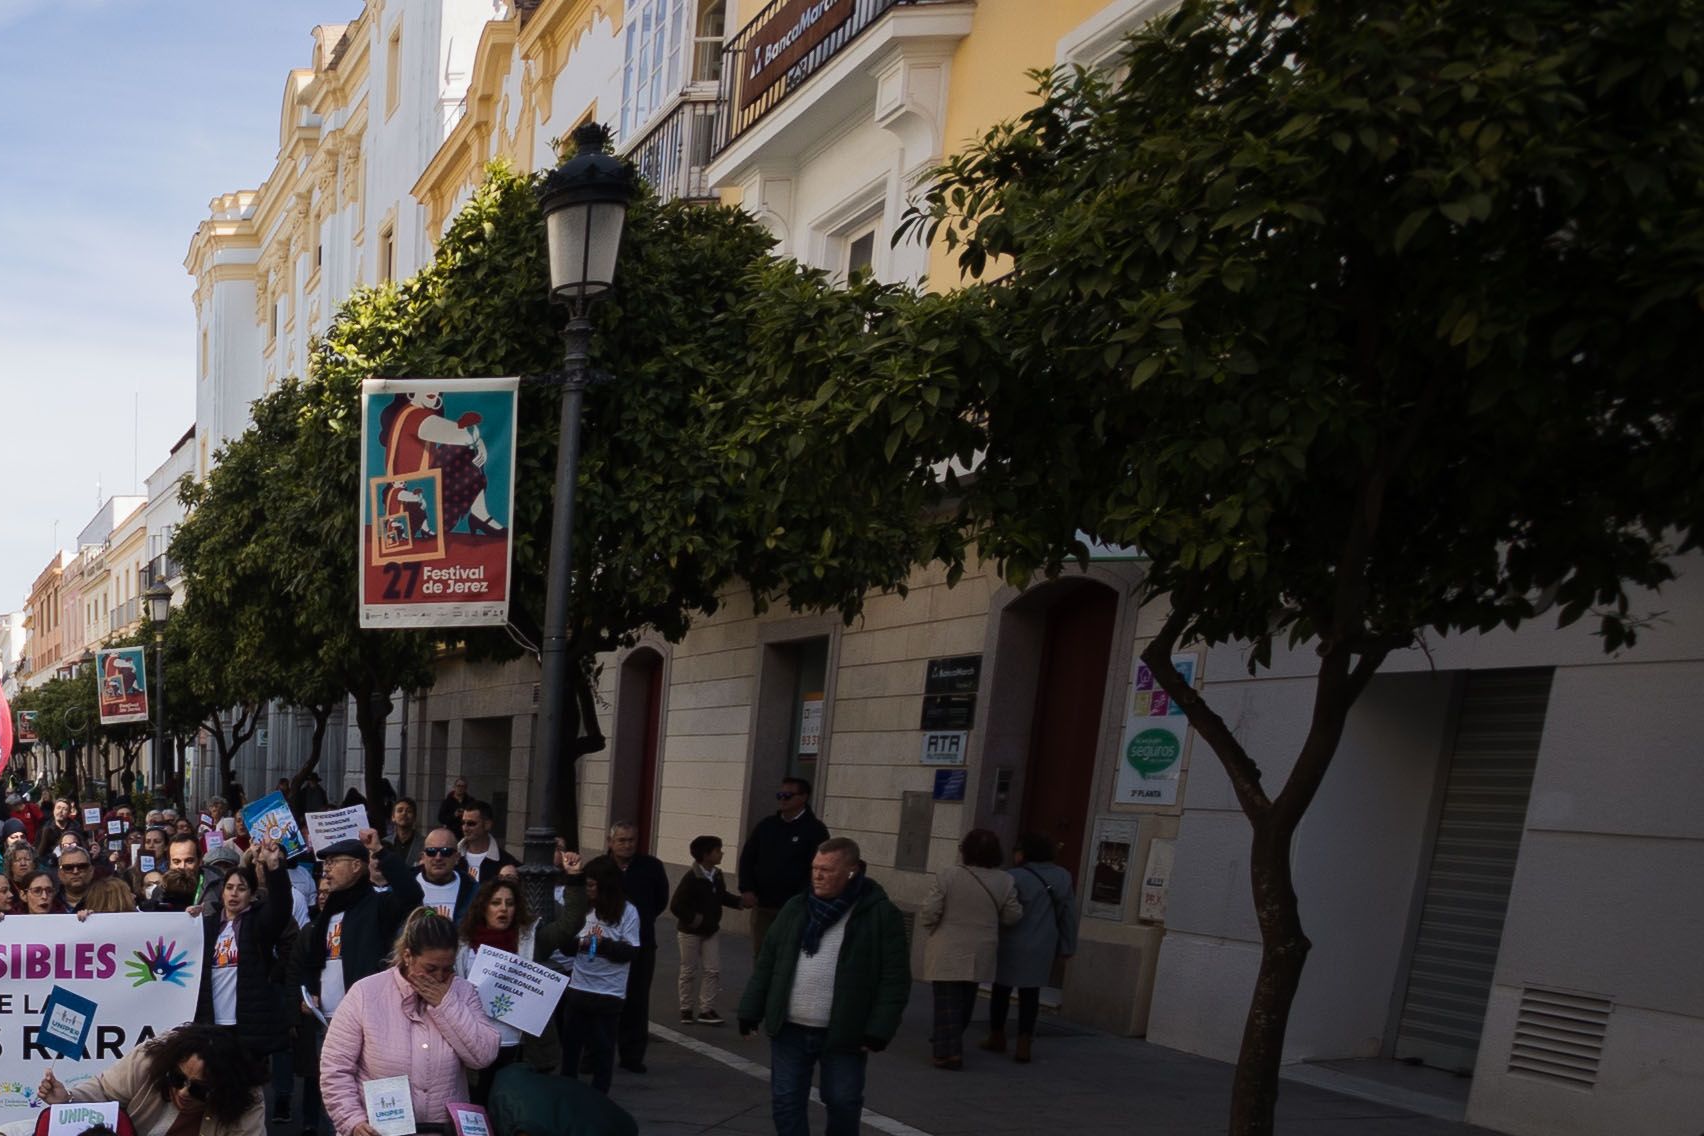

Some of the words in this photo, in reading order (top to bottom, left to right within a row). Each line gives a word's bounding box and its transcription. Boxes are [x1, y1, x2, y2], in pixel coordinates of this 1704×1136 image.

[764, 0, 838, 66] BancaMarc
[383, 561, 421, 600] 27
[423, 565, 484, 580] Festival
[423, 580, 442, 593] de
[446, 579, 488, 593] Jerez
[1130, 745, 1176, 760] seguros
[482, 949, 508, 961] SOMOS
[509, 957, 518, 965] LA
[518, 961, 562, 983] ASOCIACIÓN
[52, 1020, 79, 1036] UNIPER
[59, 1108, 104, 1125] UNIPER
[375, 1108, 404, 1118] UNIPER
